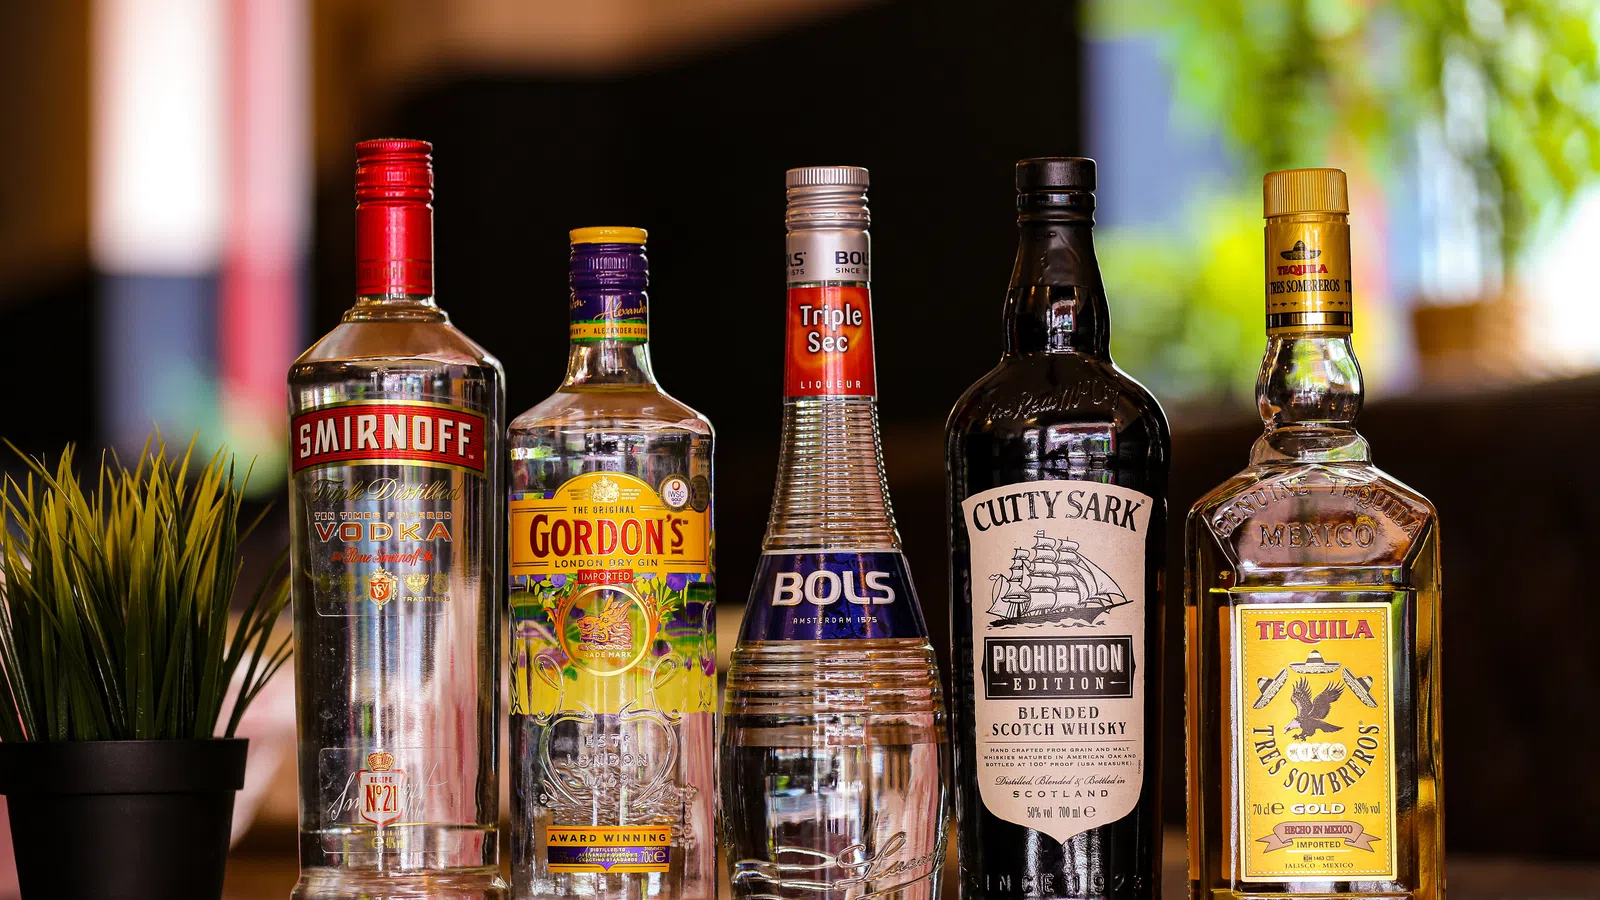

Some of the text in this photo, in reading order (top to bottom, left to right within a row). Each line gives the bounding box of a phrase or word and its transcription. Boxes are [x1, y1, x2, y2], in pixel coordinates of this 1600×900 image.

[835, 251, 869, 265] BOL
[1277, 264, 1328, 276] TEQUILA
[1270, 280, 1285, 294] TRES
[1286, 279, 1340, 293] SOMBREROS
[800, 303, 862, 331] Triple
[593, 327, 632, 335] ALEXANDER
[808, 332, 848, 353] Sec
[800, 380, 861, 389] LIQUEUR
[300, 414, 471, 459] SMIRNOFF
[310, 477, 464, 503] Triple Distilled
[573, 506, 635, 514] THE ORIGINAL
[973, 490, 1141, 532] CUTTY SARK
[1212, 475, 1423, 539] GENUINE TEQUILA
[315, 511, 452, 520] TEN TIMES FILTERED
[314, 521, 452, 542] VODKA
[530, 514, 684, 558] GORDON'S
[1260, 523, 1375, 549] MEXICO
[373, 547, 422, 566] Smirnoff
[555, 560, 603, 568] LONDON
[638, 559, 658, 567] GIN
[581, 572, 630, 581] IMPORTED
[772, 570, 896, 607] BOLS
[793, 616, 852, 624] AMSTERDAM
[1256, 620, 1374, 644] TEQUILA
[993, 644, 1124, 674] PROHIBITION
[1013, 677, 1105, 691] EDITION
[1018, 706, 1099, 720] BLENDED
[992, 722, 1126, 736] SCOTCH WHISKY
[567, 754, 648, 768] LONDON
[1253, 725, 1380, 796] TRES SOMBREROS
[995, 775, 1032, 786] Distilled,
[1034, 775, 1072, 785] Blended
[1074, 777, 1084, 787] &
[1084, 775, 1116, 785] Bottled
[1012, 790, 1109, 798] SCOTLAND
[1027, 806, 1041, 819] 50%
[1043, 806, 1052, 818] vol
[1058, 807, 1070, 818] 700
[1072, 806, 1081, 818] ml
[1253, 804, 1262, 815] 70
[1290, 803, 1346, 815] GOLD
[1354, 802, 1381, 815] 38% vol
[1284, 825, 1353, 835] HECHO EN MEXICO
[550, 833, 666, 843] AWARD WINNING
[970, 873, 1055, 893] SINCE
